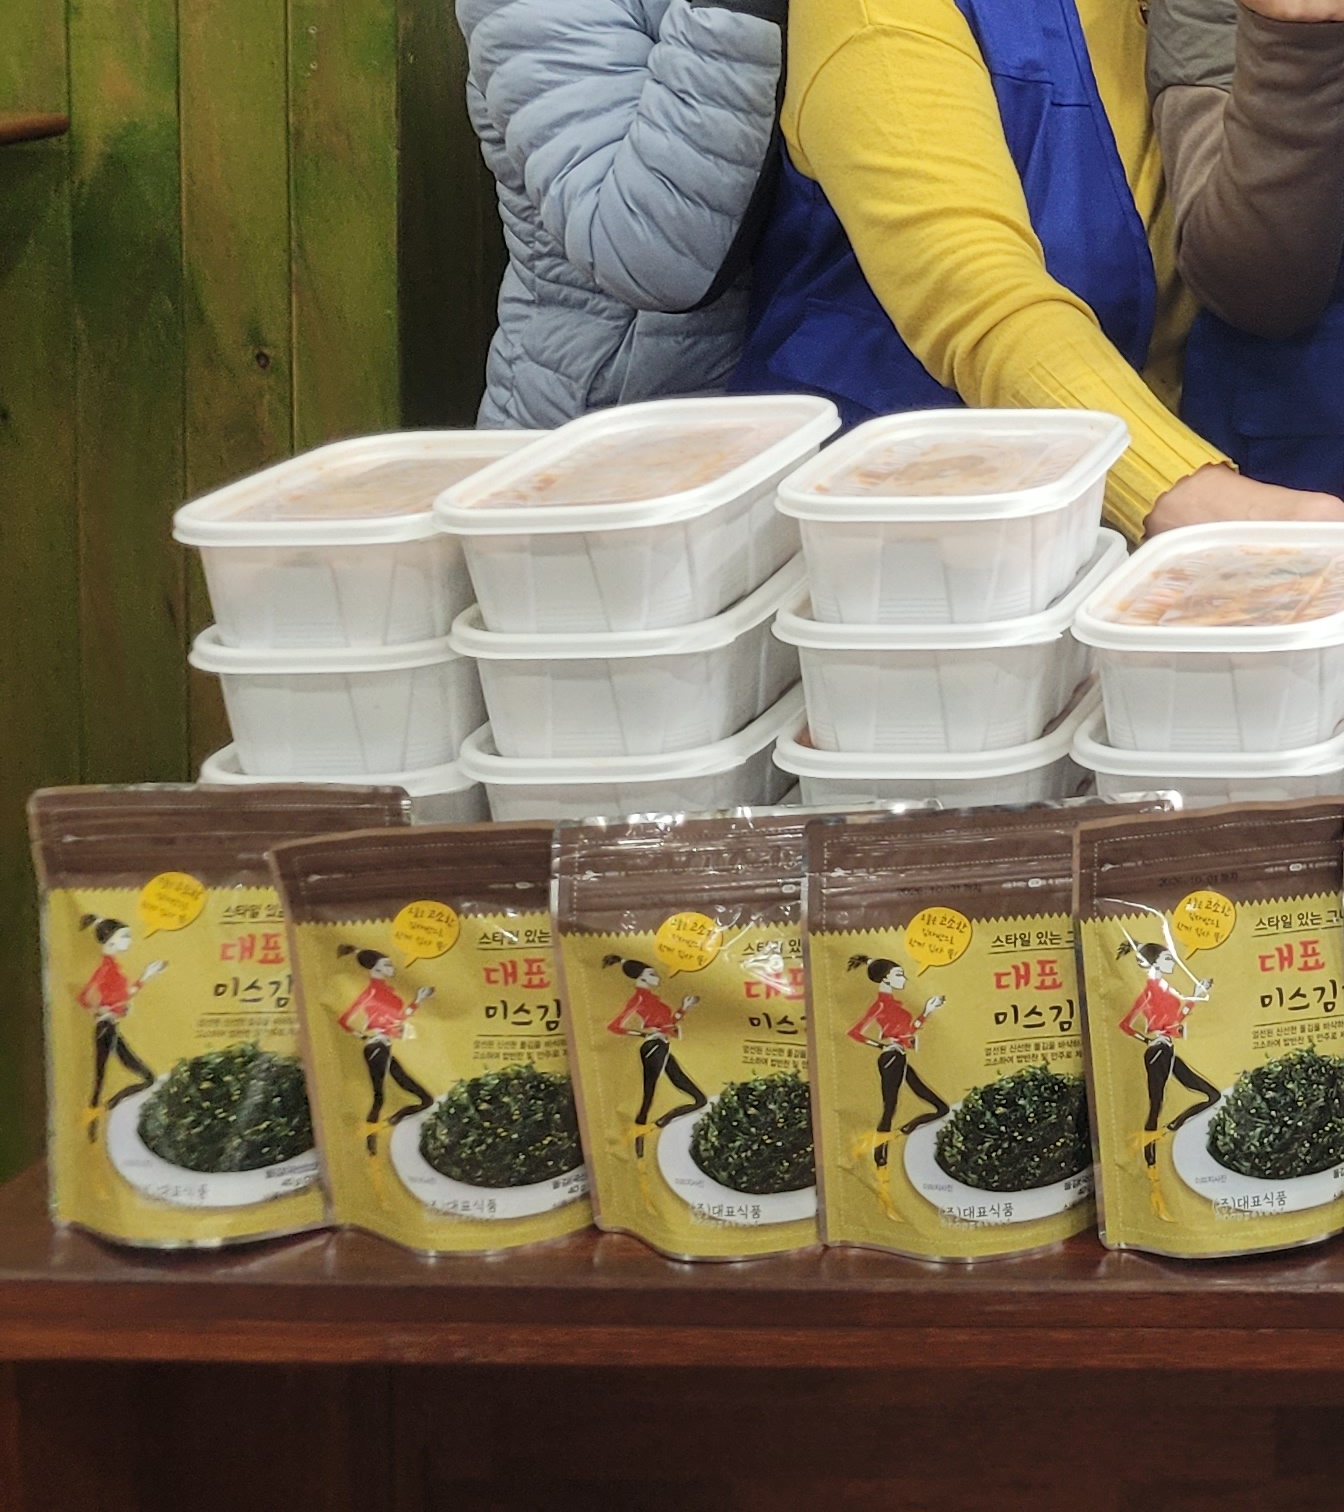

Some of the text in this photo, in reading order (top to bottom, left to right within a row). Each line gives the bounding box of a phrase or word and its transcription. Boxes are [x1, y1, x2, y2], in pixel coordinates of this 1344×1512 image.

[1254, 912, 1292, 930] 스타일
[1297, 911, 1322, 927] 있는
[524, 929, 552, 944] 있는
[991, 931, 1062, 948] 스타일 있는
[220, 932, 284, 964] 대표
[1258, 939, 1325, 972] 대표
[483, 958, 551, 989] 대표
[993, 959, 1063, 991] 대표
[748, 1012, 806, 1036] 미스
[940, 1202, 1014, 1220] (주)대표식품
[1213, 1190, 1287, 1211] (주)대표식품
